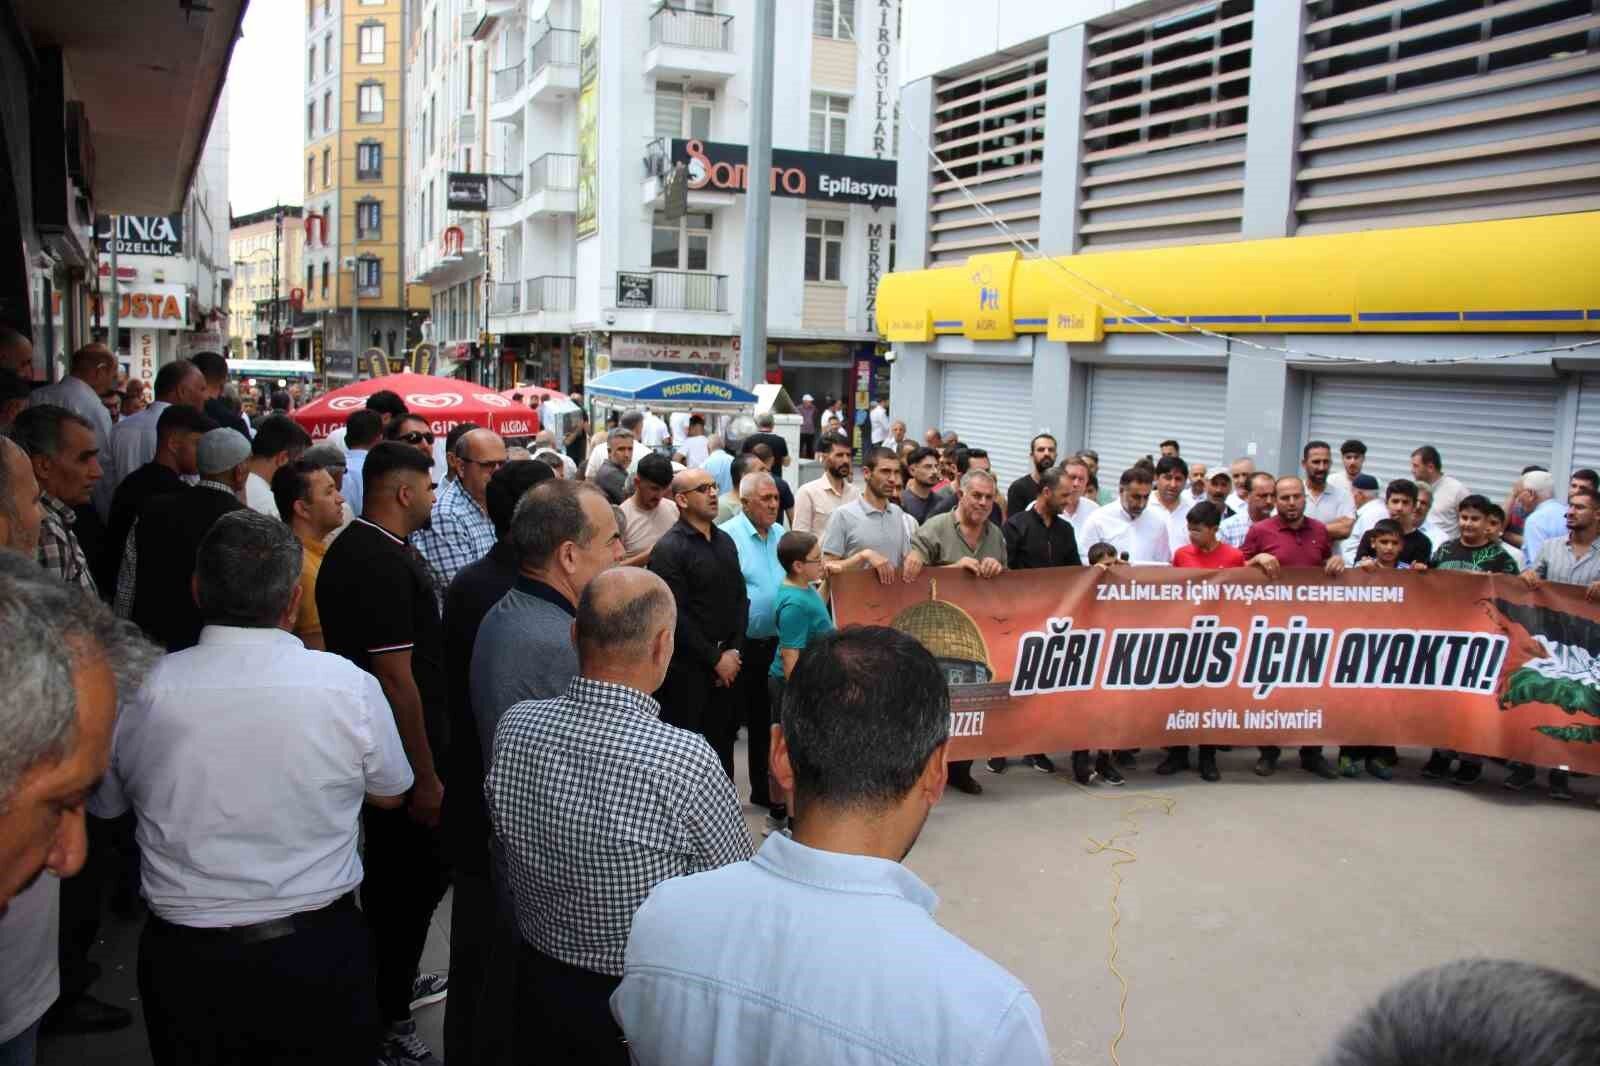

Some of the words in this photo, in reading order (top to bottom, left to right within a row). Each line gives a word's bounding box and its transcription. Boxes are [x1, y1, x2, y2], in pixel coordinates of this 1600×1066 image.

[818, 175, 897, 199] Epilasyon
[501, 421, 529, 433] ALGIDA
[1096, 580, 1183, 601] ZALİMLER
[1186, 580, 1220, 605] İÇİN
[1223, 584, 1293, 605] YAŞASIN
[1296, 585, 1404, 603] CEHENNEM!
[1011, 619, 1102, 694] AĞRI
[1103, 618, 1240, 687] KUDÜS
[1240, 617, 1332, 697] İÇİN
[1332, 629, 1507, 694] AYAKTA!
[1166, 710, 1200, 730] AĞRI
[1202, 709, 1240, 729] SİVİL
